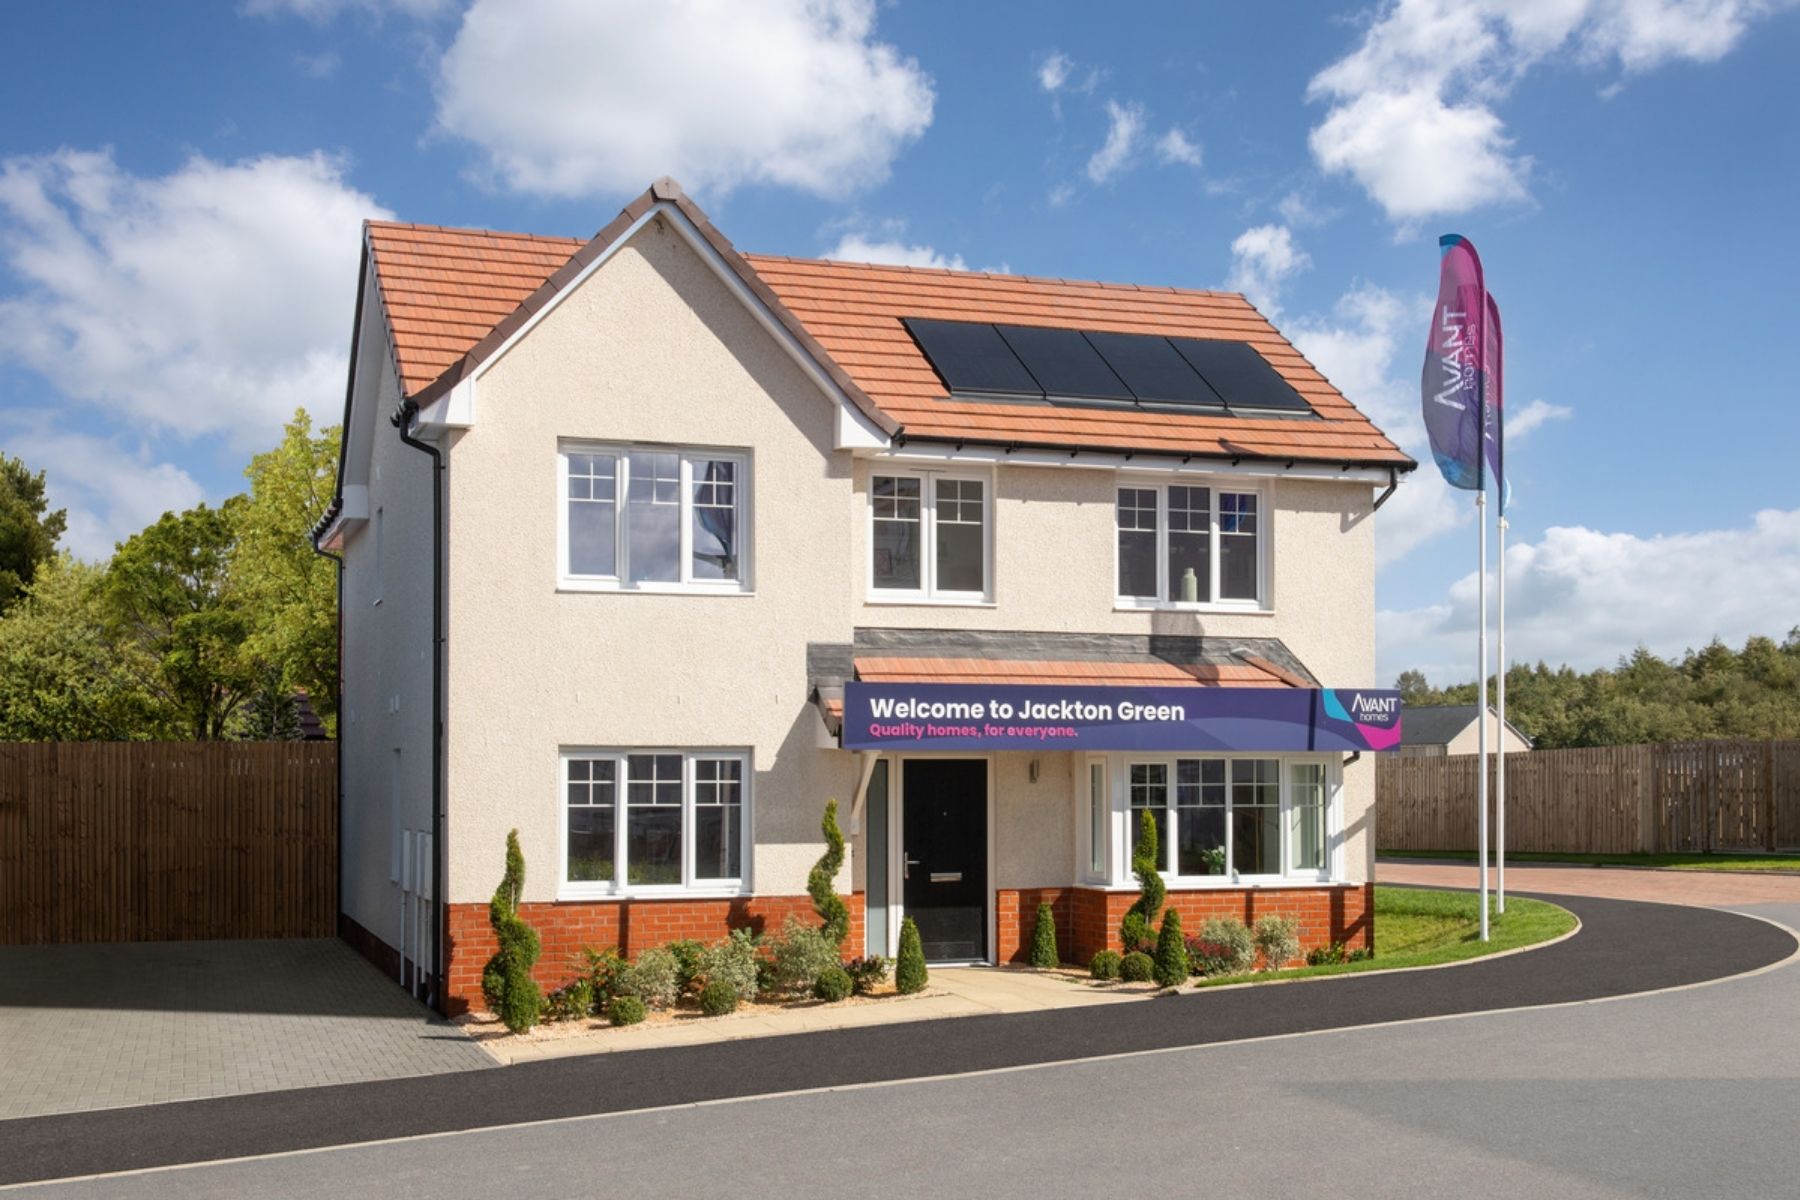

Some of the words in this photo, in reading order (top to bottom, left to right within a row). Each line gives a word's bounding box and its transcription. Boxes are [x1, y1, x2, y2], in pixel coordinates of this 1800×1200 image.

[1433, 305, 1467, 411] AVANT
[870, 698, 985, 719] Welcome
[989, 700, 1013, 719] to
[1018, 700, 1113, 720] Jackton
[1117, 701, 1185, 721] Green
[1351, 693, 1398, 712] AVANT
[1360, 713, 1389, 722] homes
[869, 722, 925, 740] Quality
[927, 723, 982, 738] homes,
[984, 723, 1005, 737] for
[1007, 726, 1079, 740] everyone.
